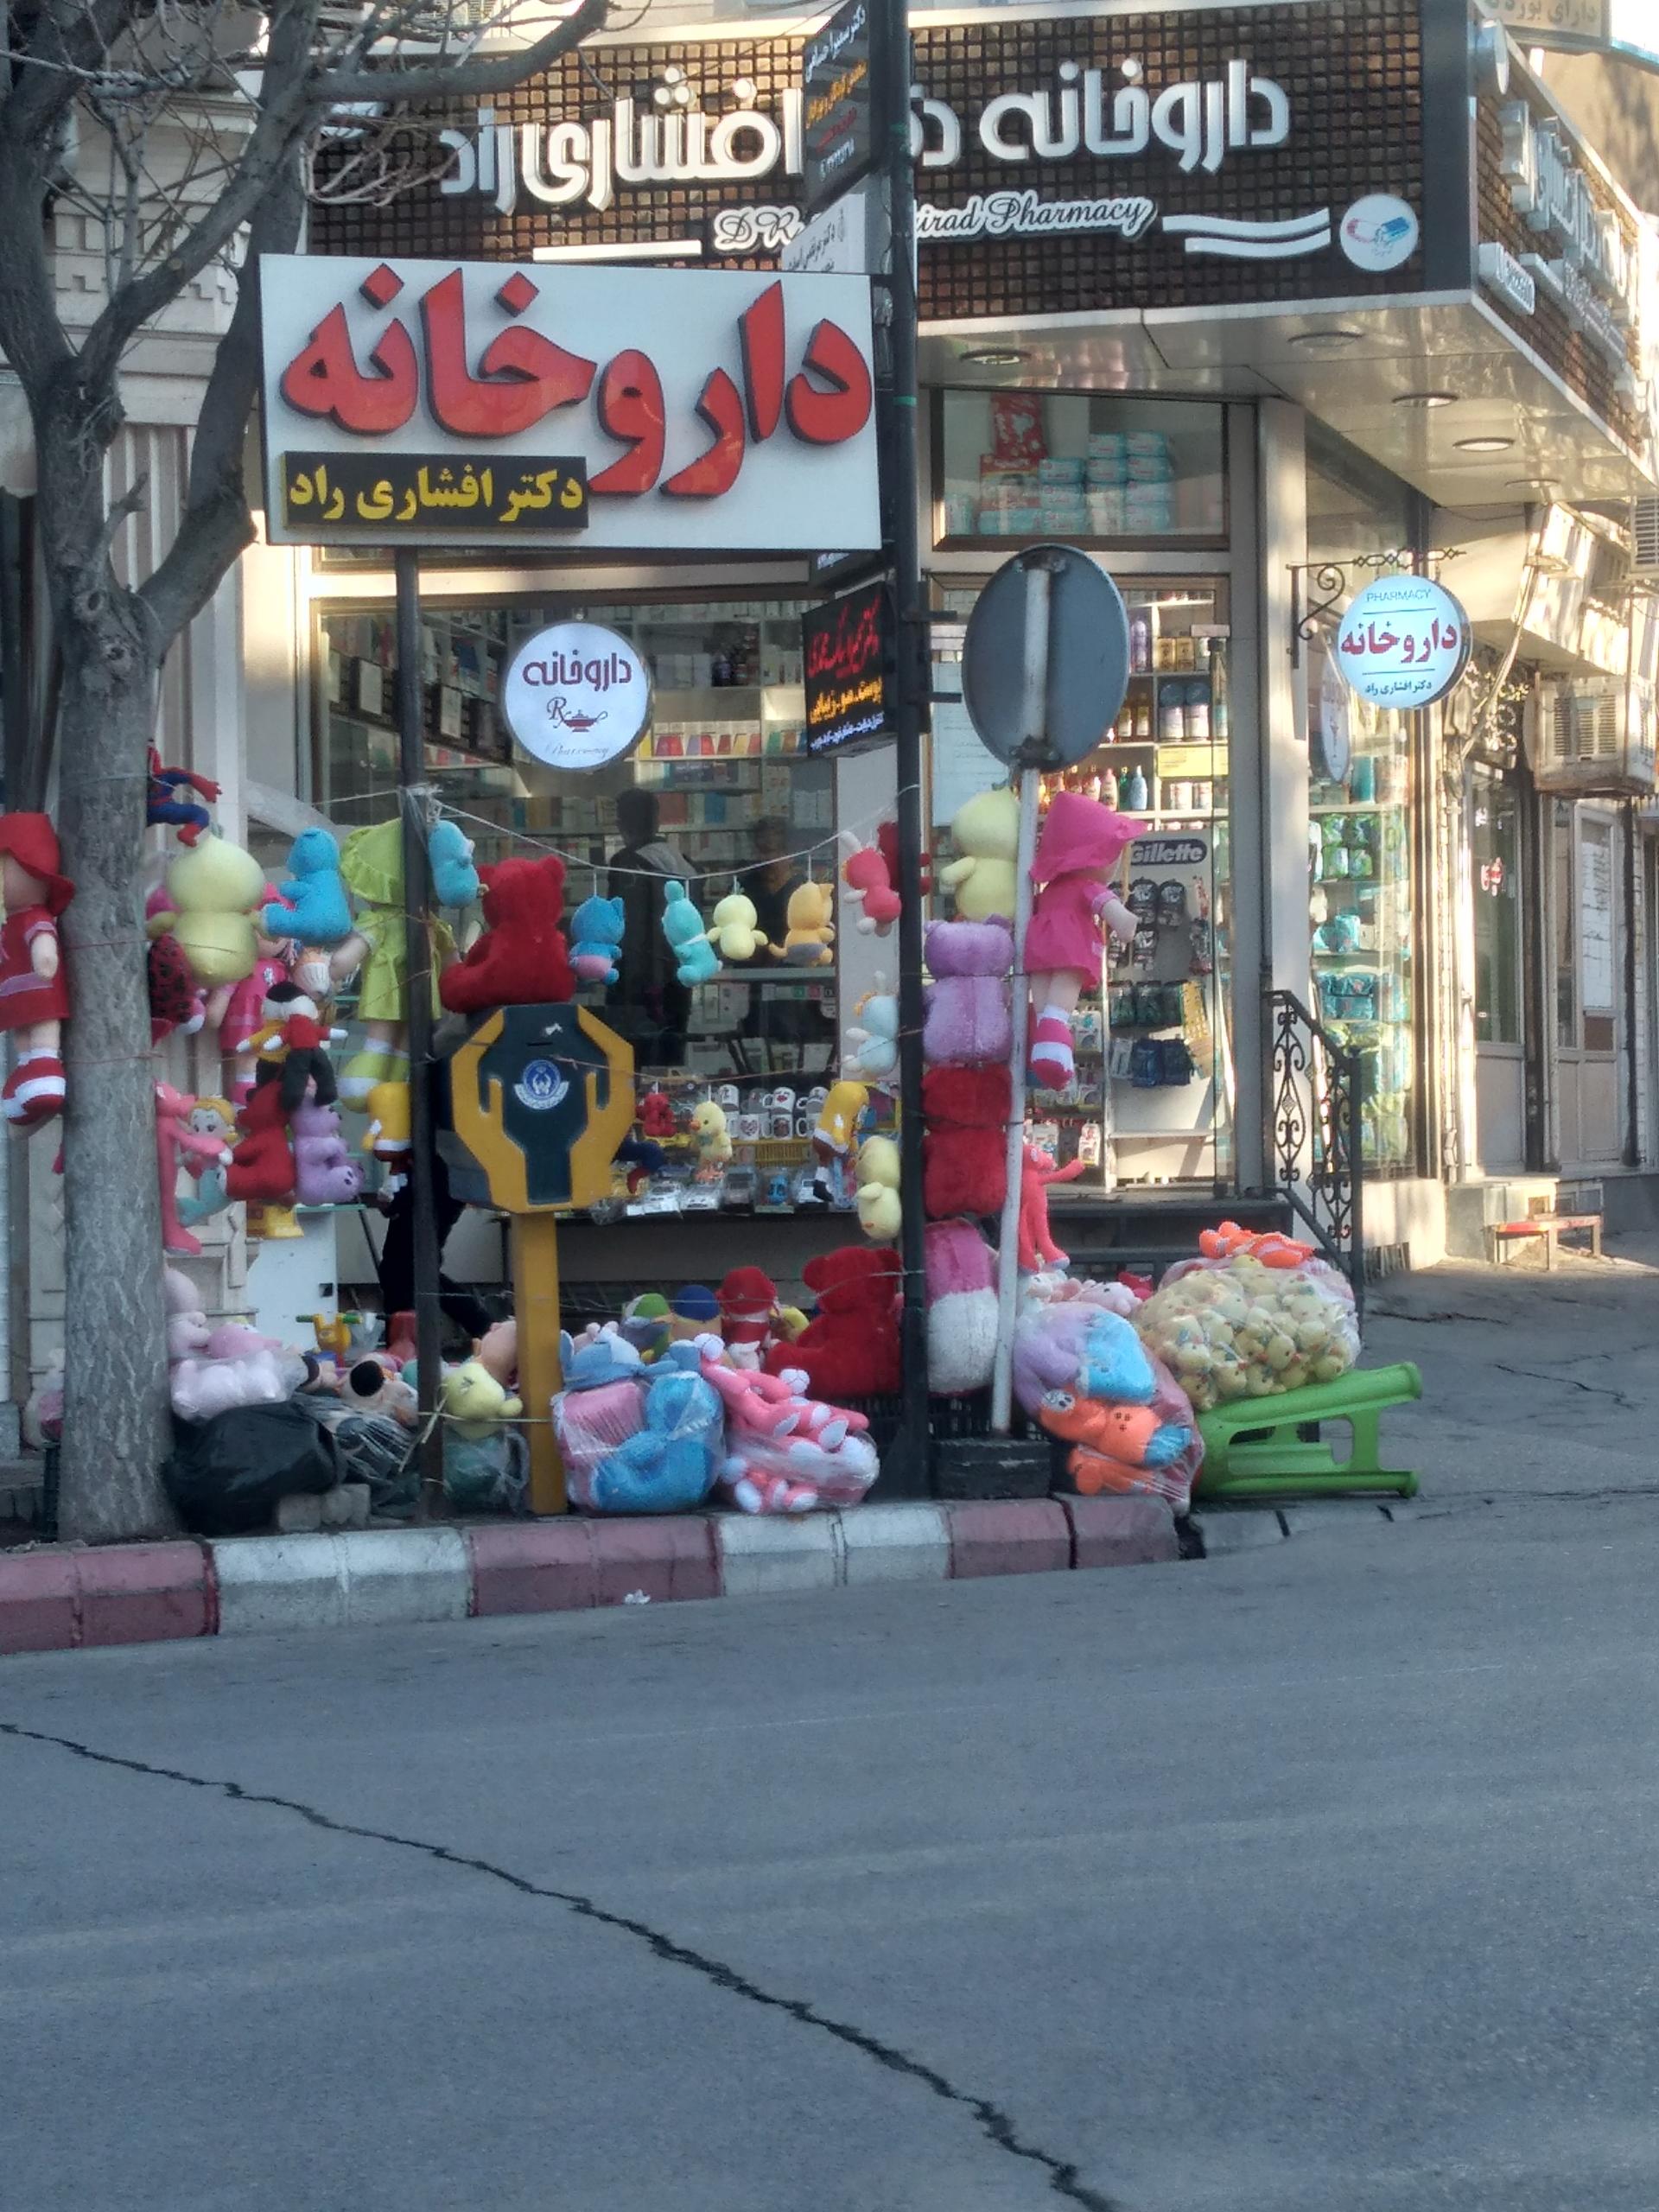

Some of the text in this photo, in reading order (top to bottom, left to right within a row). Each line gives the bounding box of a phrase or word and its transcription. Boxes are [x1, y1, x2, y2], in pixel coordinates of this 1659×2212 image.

[979, 58, 1290, 172] داروخانه
[439, 107, 516, 216] راد
[522, 67, 804, 212] افشاری
[985, 190, 1154, 238] Pharmacy
[281, 262, 873, 495] داروخانه
[290, 464, 584, 522] دکتر افشاری راد
[1366, 589, 1432, 602] PHARMACY
[1340, 617, 1459, 664] داروخانه
[523, 649, 632, 691] داروخانه
[1364, 679, 1433, 696] دکتر افشاری راد
[1131, 843, 1203, 863] Gillette
